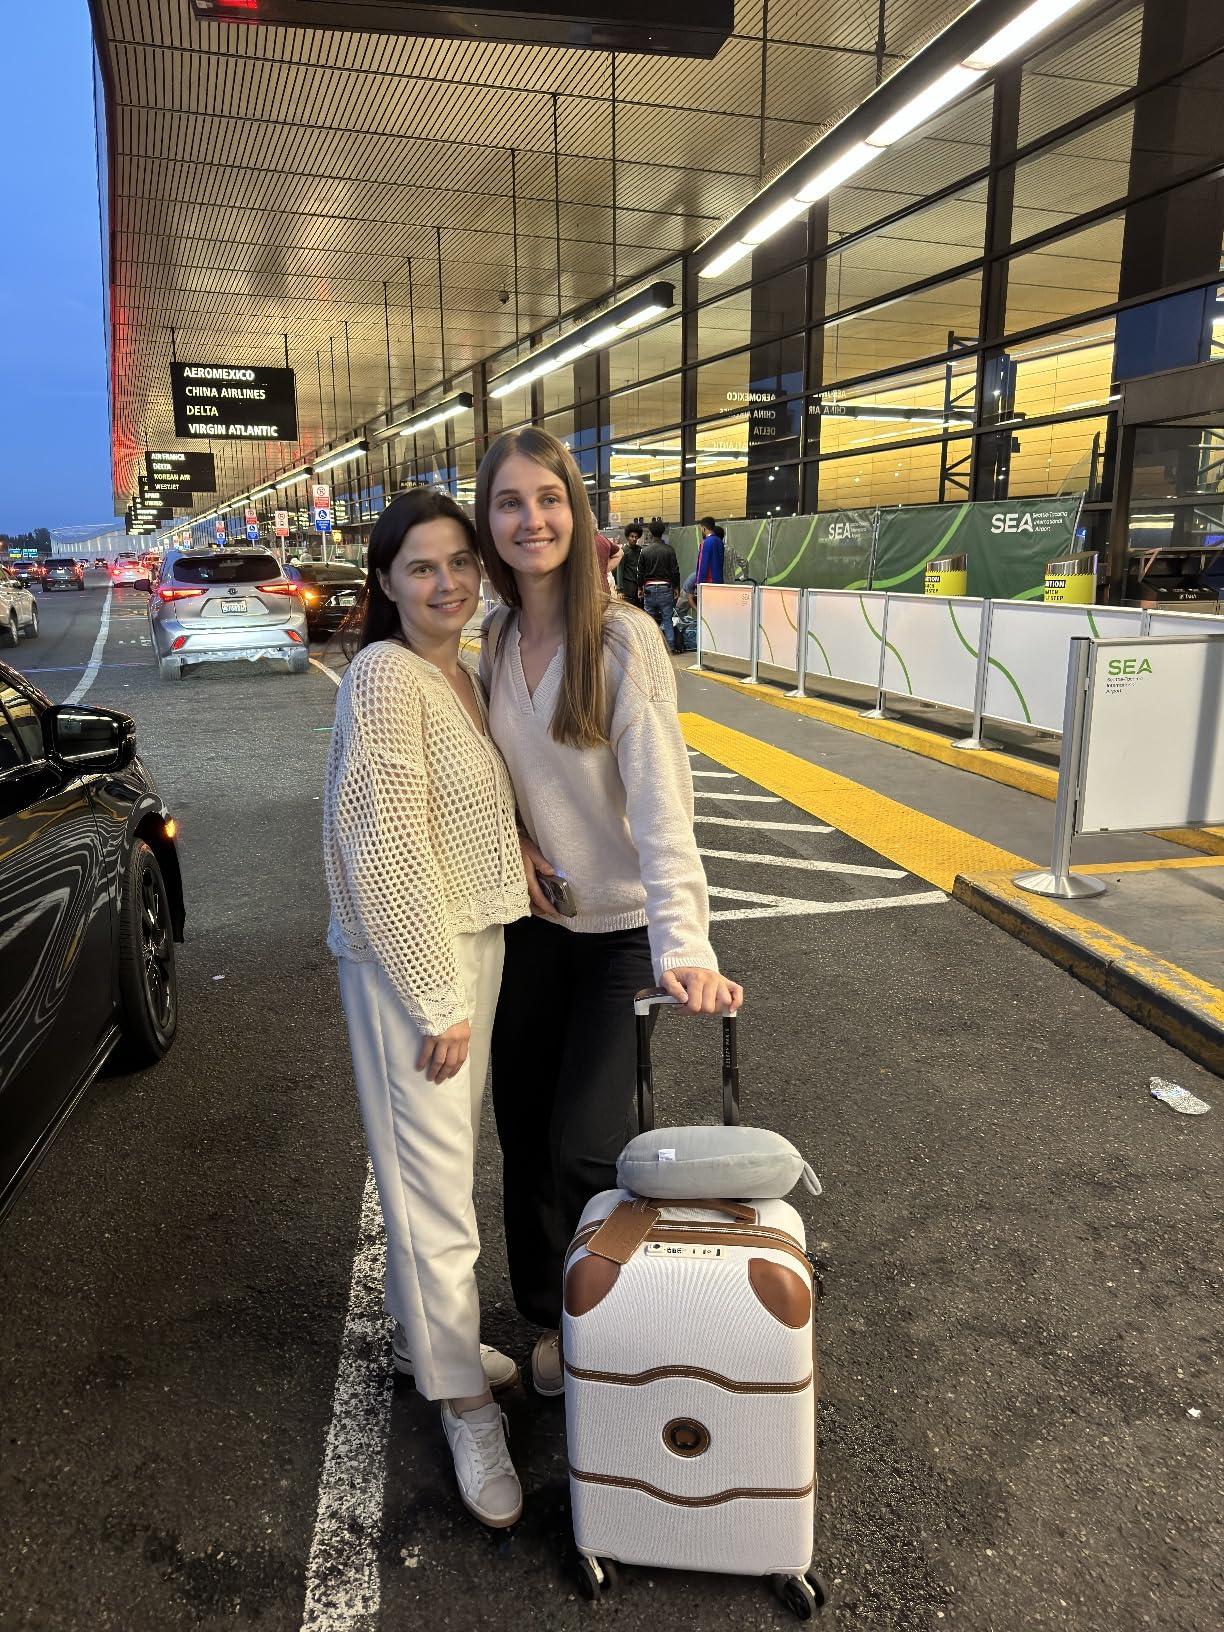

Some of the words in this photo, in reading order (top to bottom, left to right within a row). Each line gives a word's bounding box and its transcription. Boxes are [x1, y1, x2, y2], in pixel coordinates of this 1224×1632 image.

[183, 366, 255, 381] AEROMEXICO
[185, 386, 219, 398] CHINA
[220, 387, 266, 400] AIRLINES
[186, 405, 219, 417] DELTA
[188, 423, 226, 435] VIRGIN
[228, 425, 279, 437] ATLANTIC
[152, 462, 172, 470] DELTA
[153, 473, 179, 481] KOREAN
[990, 512, 1034, 534] SEA
[828, 522, 851, 540] SEA
[1107, 658, 1153, 676] SEA
